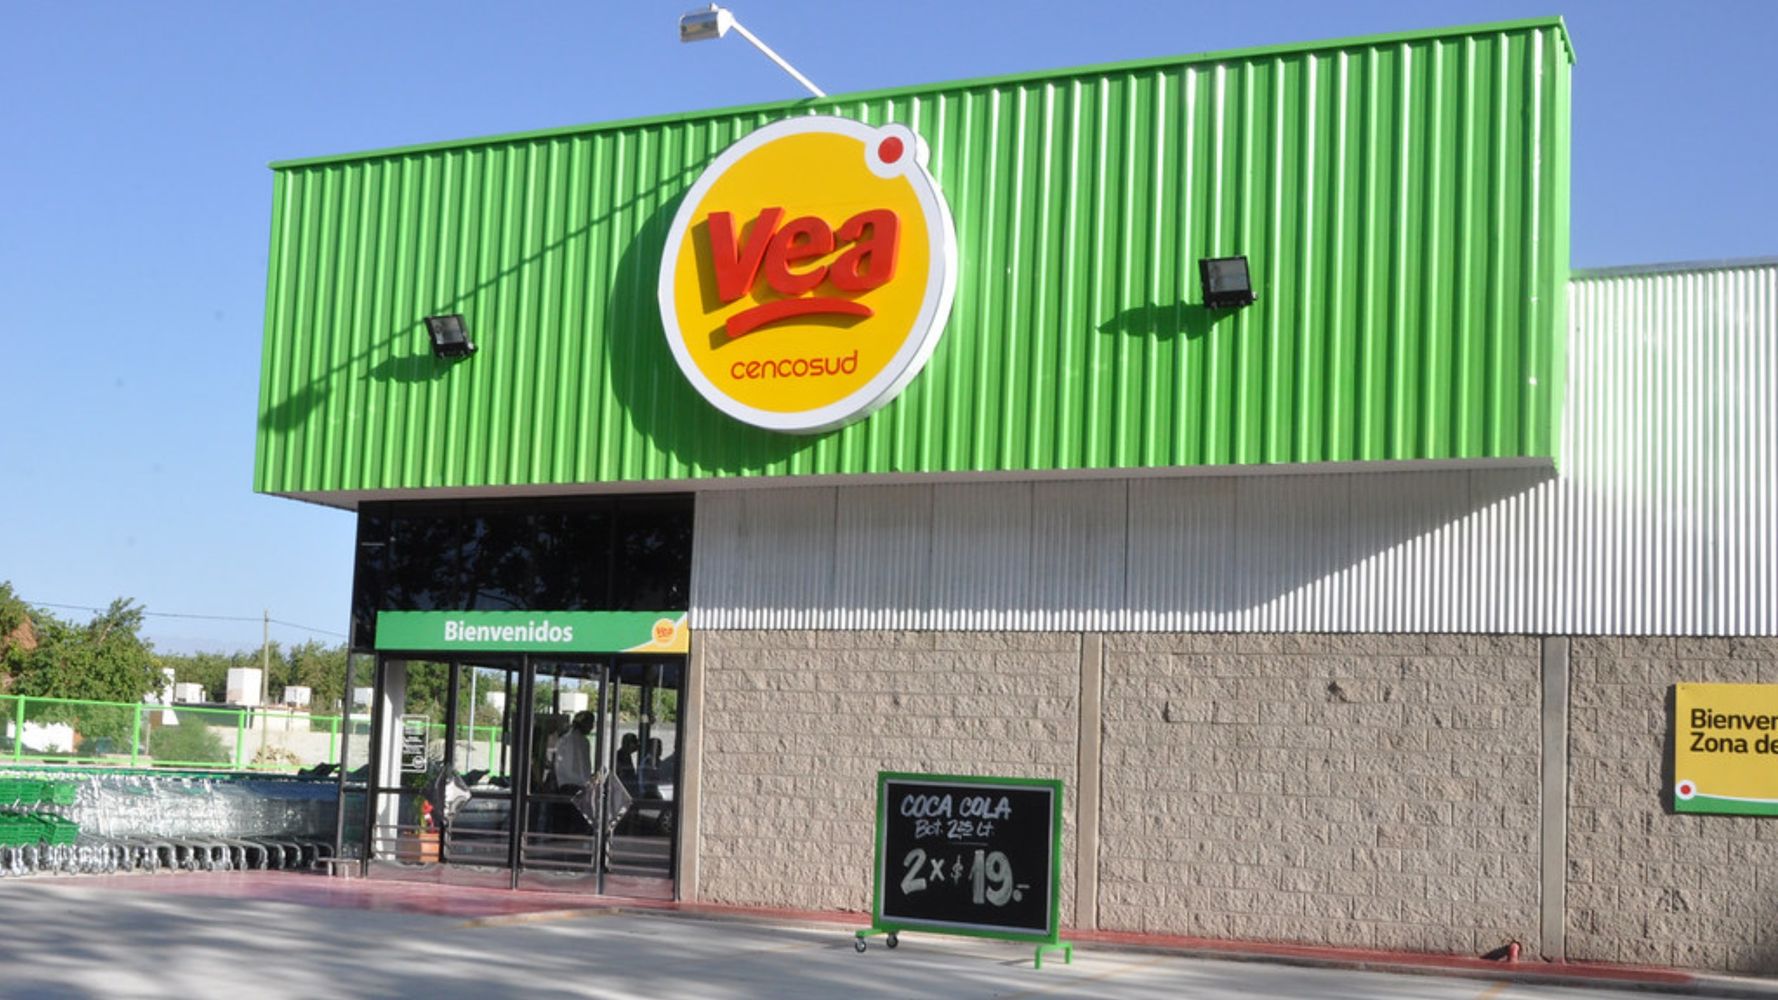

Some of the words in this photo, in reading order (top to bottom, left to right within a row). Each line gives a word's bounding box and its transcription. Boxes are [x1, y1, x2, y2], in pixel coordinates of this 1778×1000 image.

[730, 350, 859, 380] cencosud
[444, 620, 573, 643] Bienvenidos
[1690, 731, 1748, 753] Zona
[900, 794, 952, 819] COCA
[959, 796, 1012, 820] COLA
